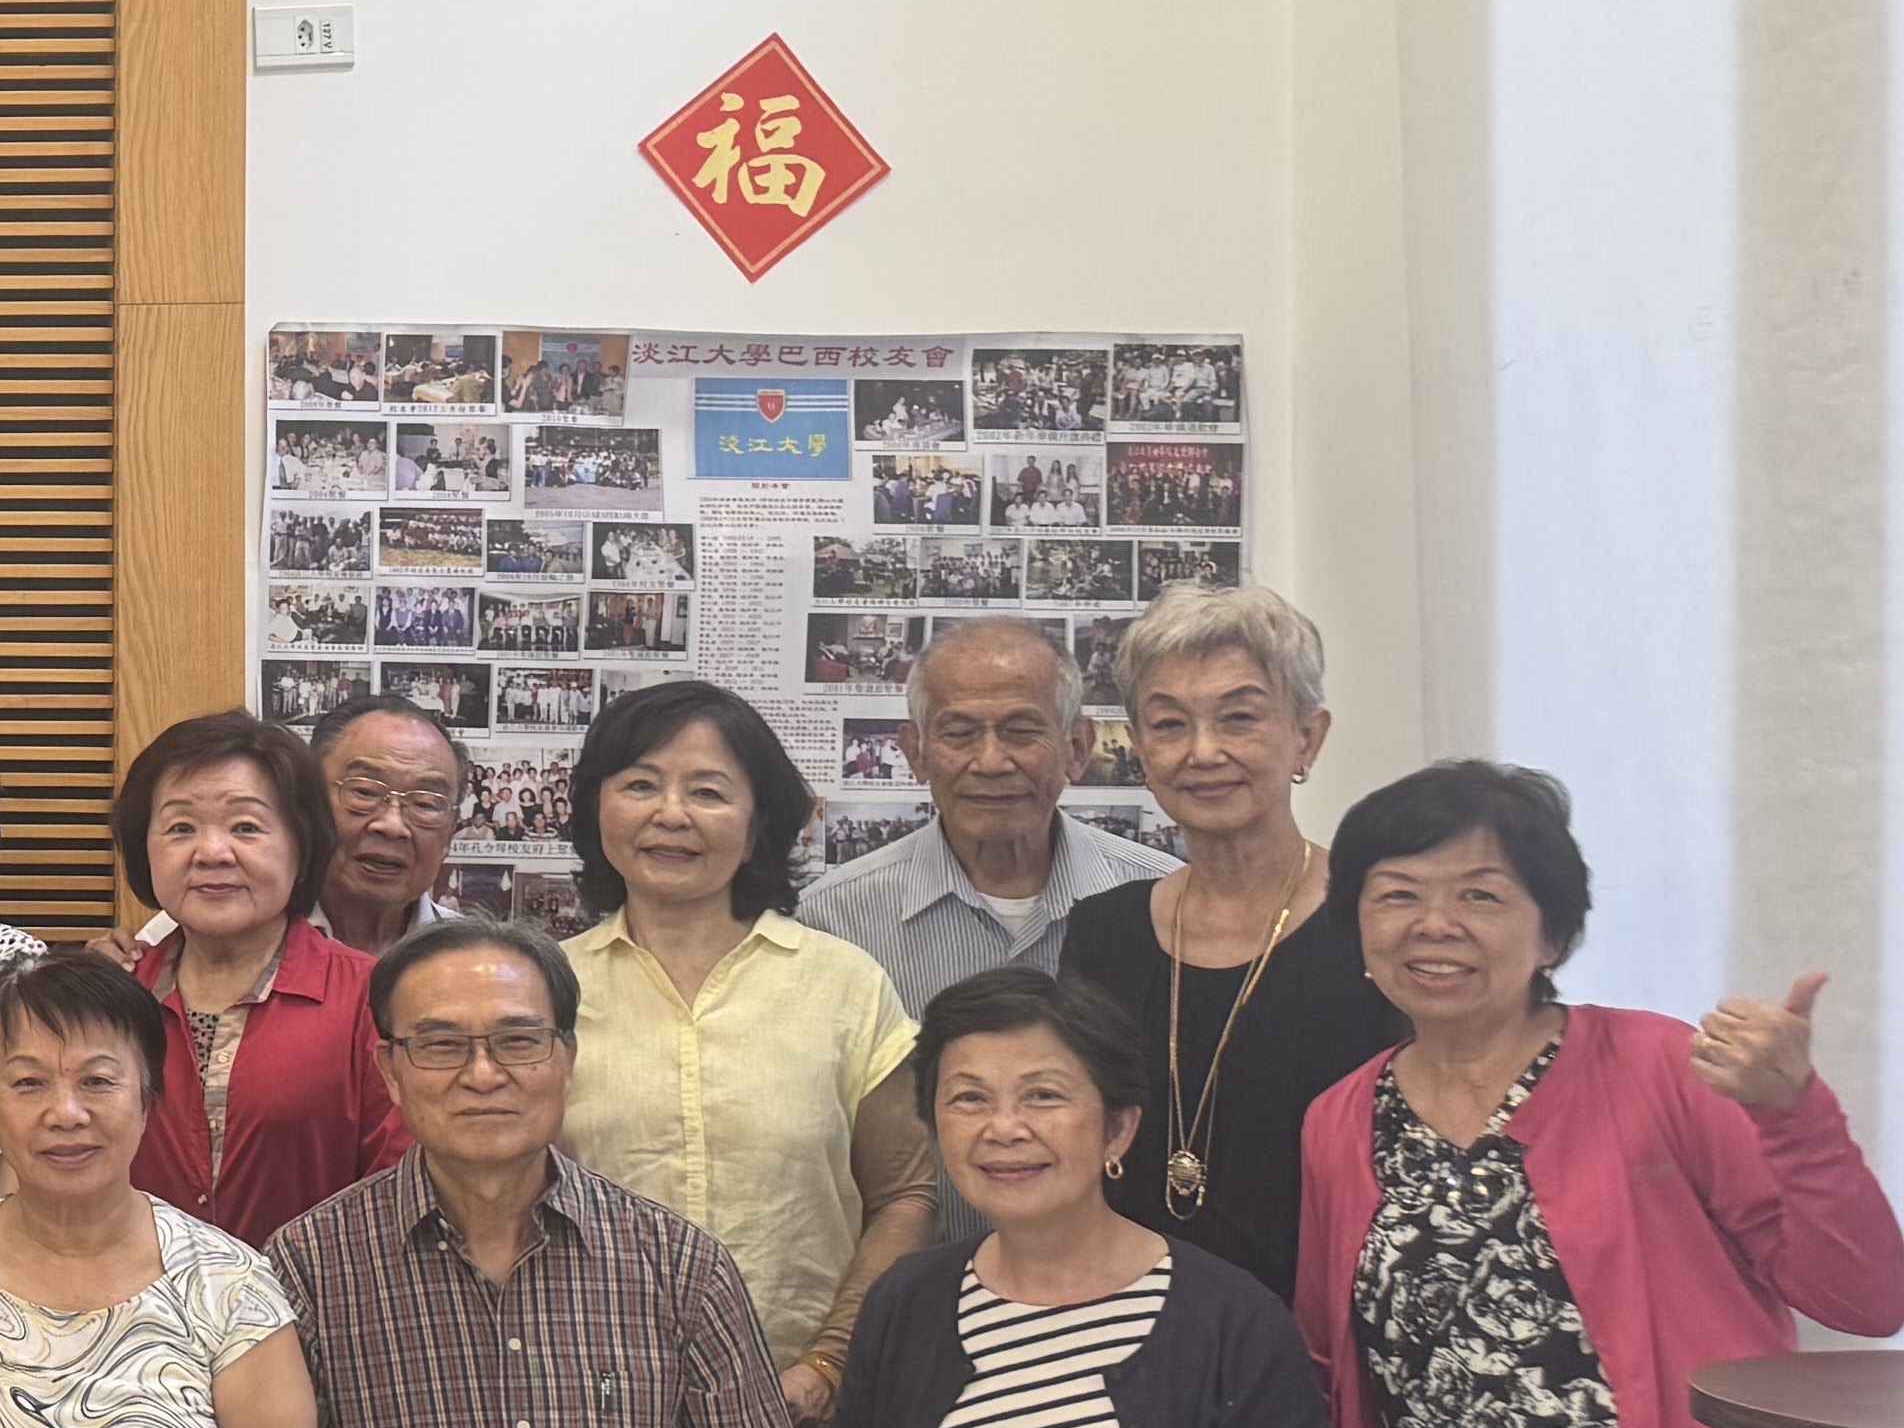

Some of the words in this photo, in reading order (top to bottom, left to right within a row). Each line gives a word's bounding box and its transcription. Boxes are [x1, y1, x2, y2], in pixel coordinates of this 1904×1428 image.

[691, 91, 827, 218] 福
[632, 342, 955, 368] 淡江大學巴西校友會
